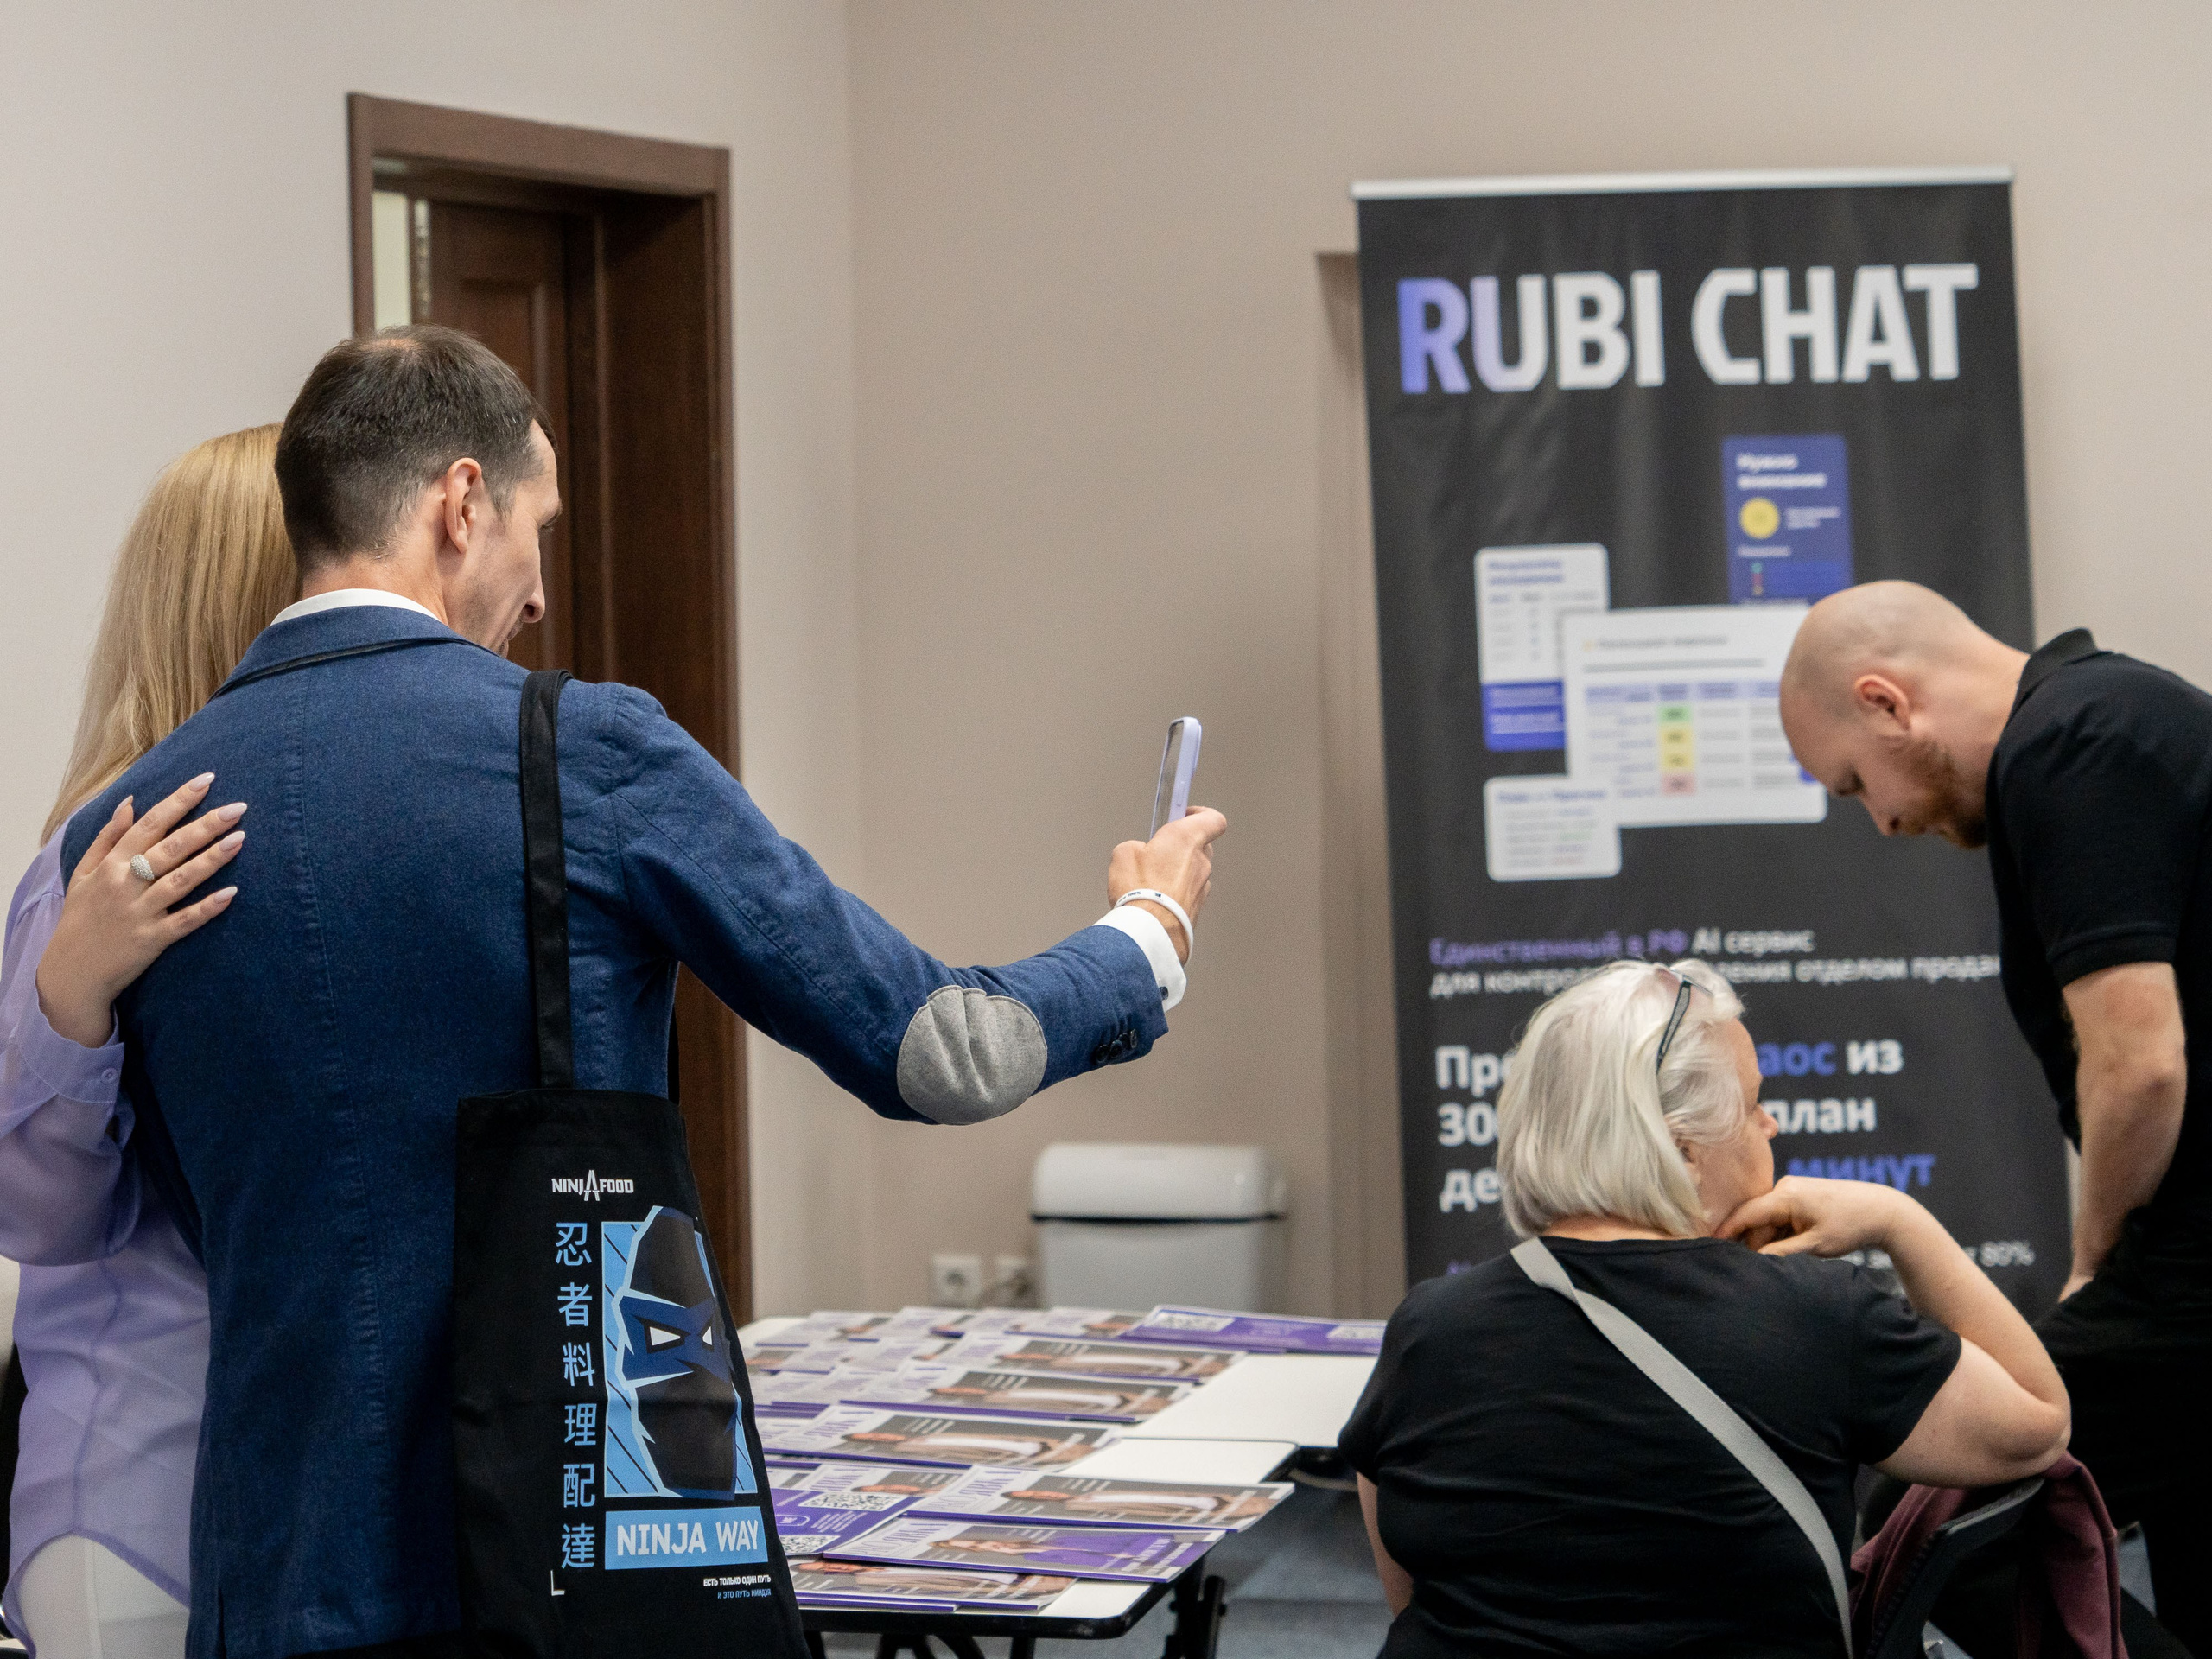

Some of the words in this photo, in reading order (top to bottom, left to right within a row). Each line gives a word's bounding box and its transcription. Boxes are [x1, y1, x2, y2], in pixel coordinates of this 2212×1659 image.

[1397, 270, 1666, 394] RUBI
[1691, 263, 1979, 385] CHAT
[1429, 931, 1622, 967] Единственный
[1647, 928, 1688, 954] РФ
[1724, 930, 1815, 957] сервис
[1429, 970, 1481, 999] для
[1795, 957, 1907, 985] отделом
[1756, 1042, 1838, 1077] аос
[1846, 1039, 1904, 1075] из
[617, 1522, 707, 1555] NINJA
[715, 1519, 758, 1553] WAY
[703, 1578, 718, 1587] ЕСТЬ
[719, 1576, 741, 1586] ТОЛЬКО
[741, 1575, 757, 1586] ОДИН
[757, 1574, 772, 1583] ПУТЬ
[751, 1588, 772, 1597] НИНДЗЯ
